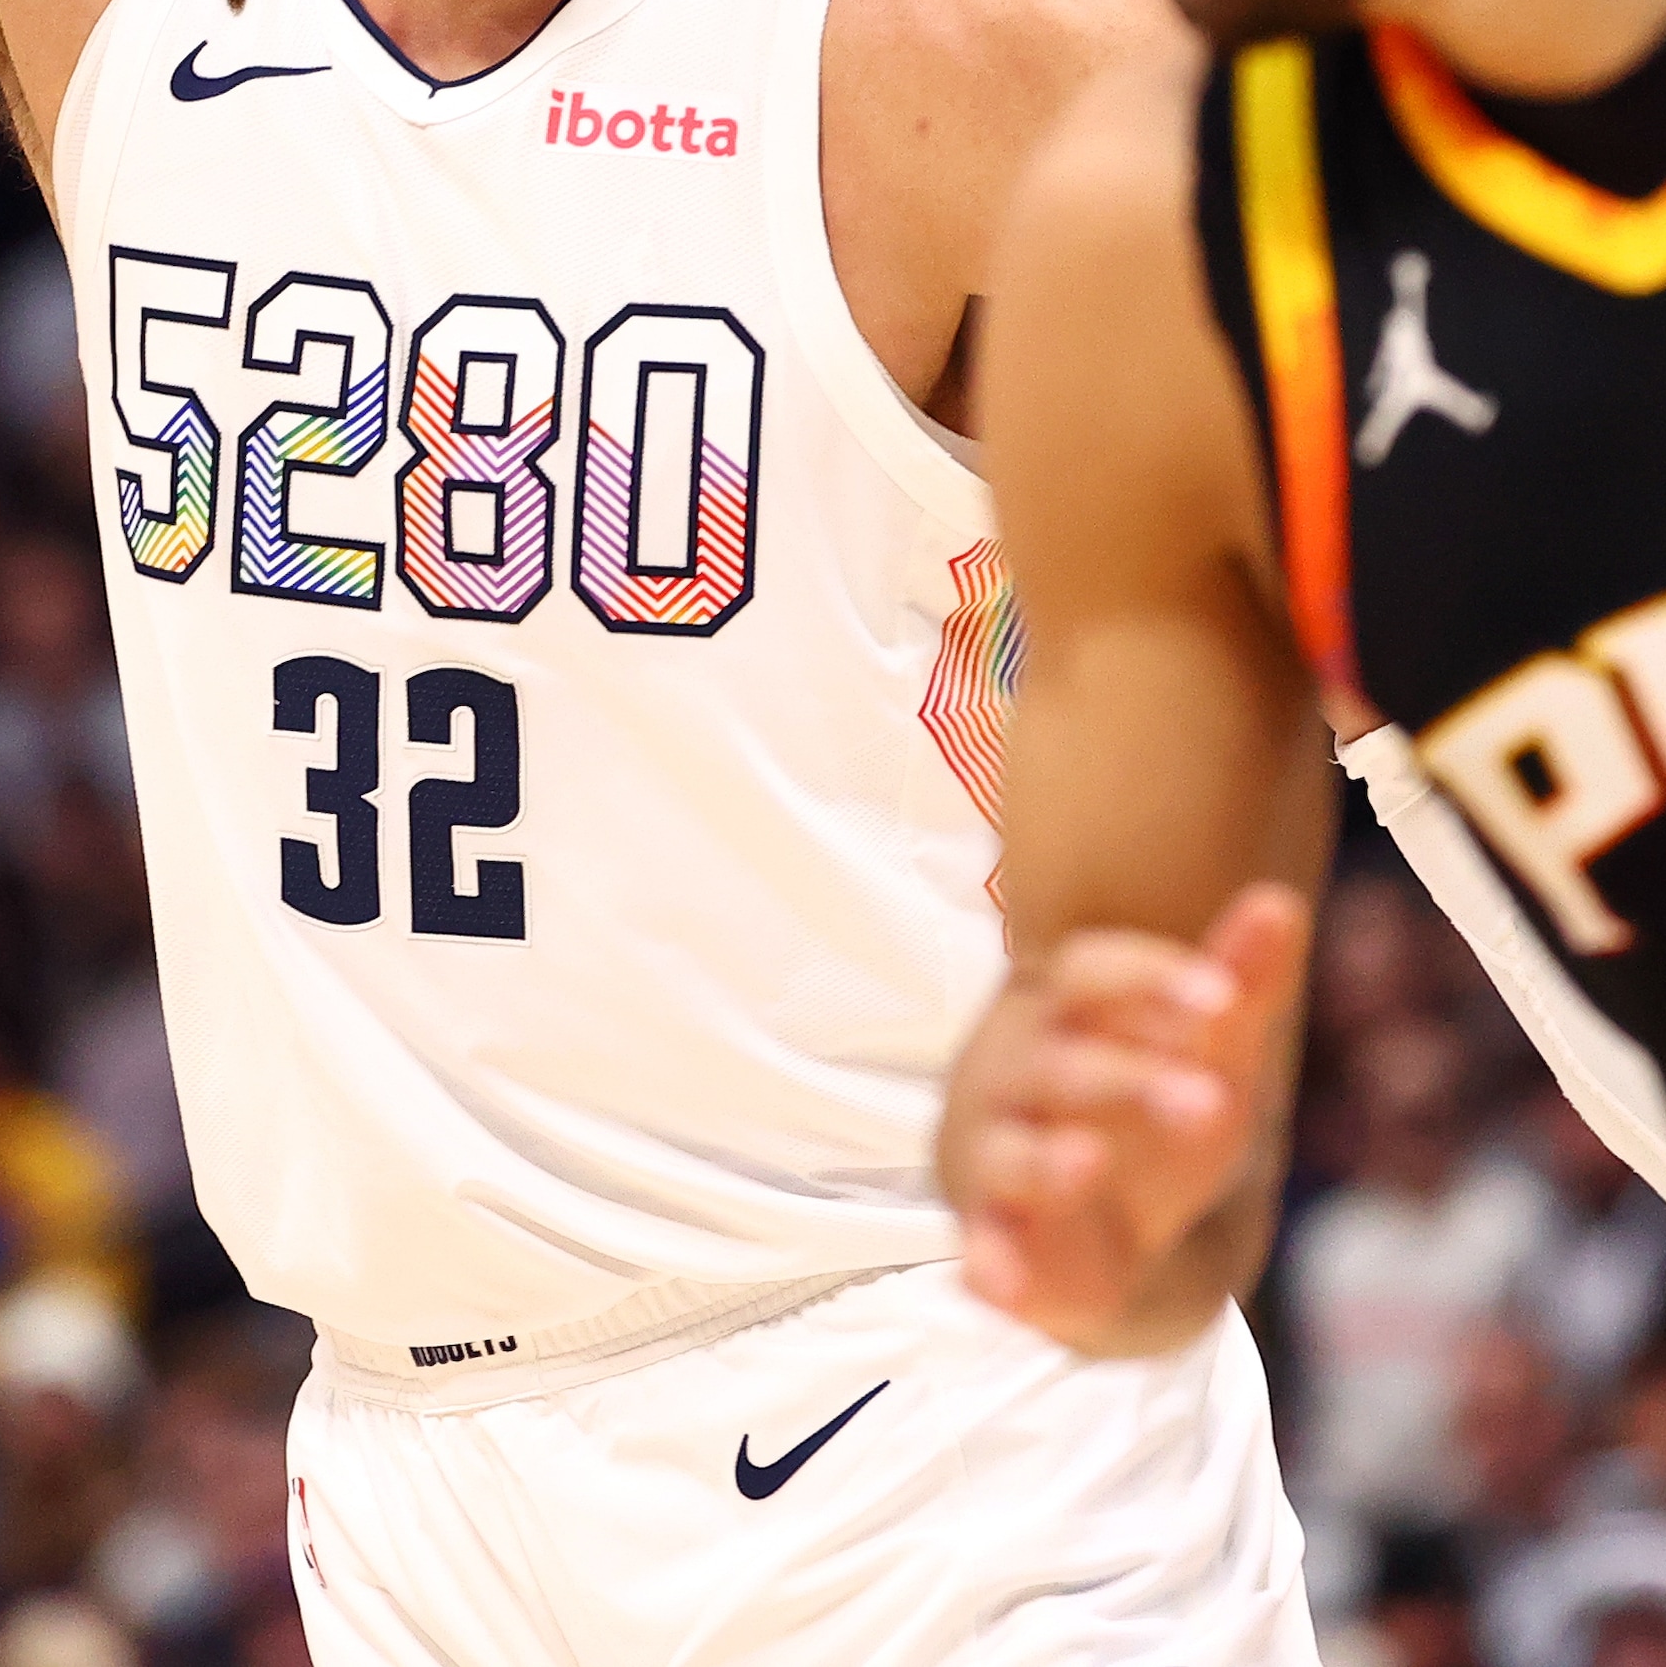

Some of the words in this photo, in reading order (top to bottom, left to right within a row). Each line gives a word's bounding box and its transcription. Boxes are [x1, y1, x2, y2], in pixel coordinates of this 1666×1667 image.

[546, 89, 738, 157] ibotta
[109, 245, 764, 637] 5280
[271, 653, 529, 942] 32
